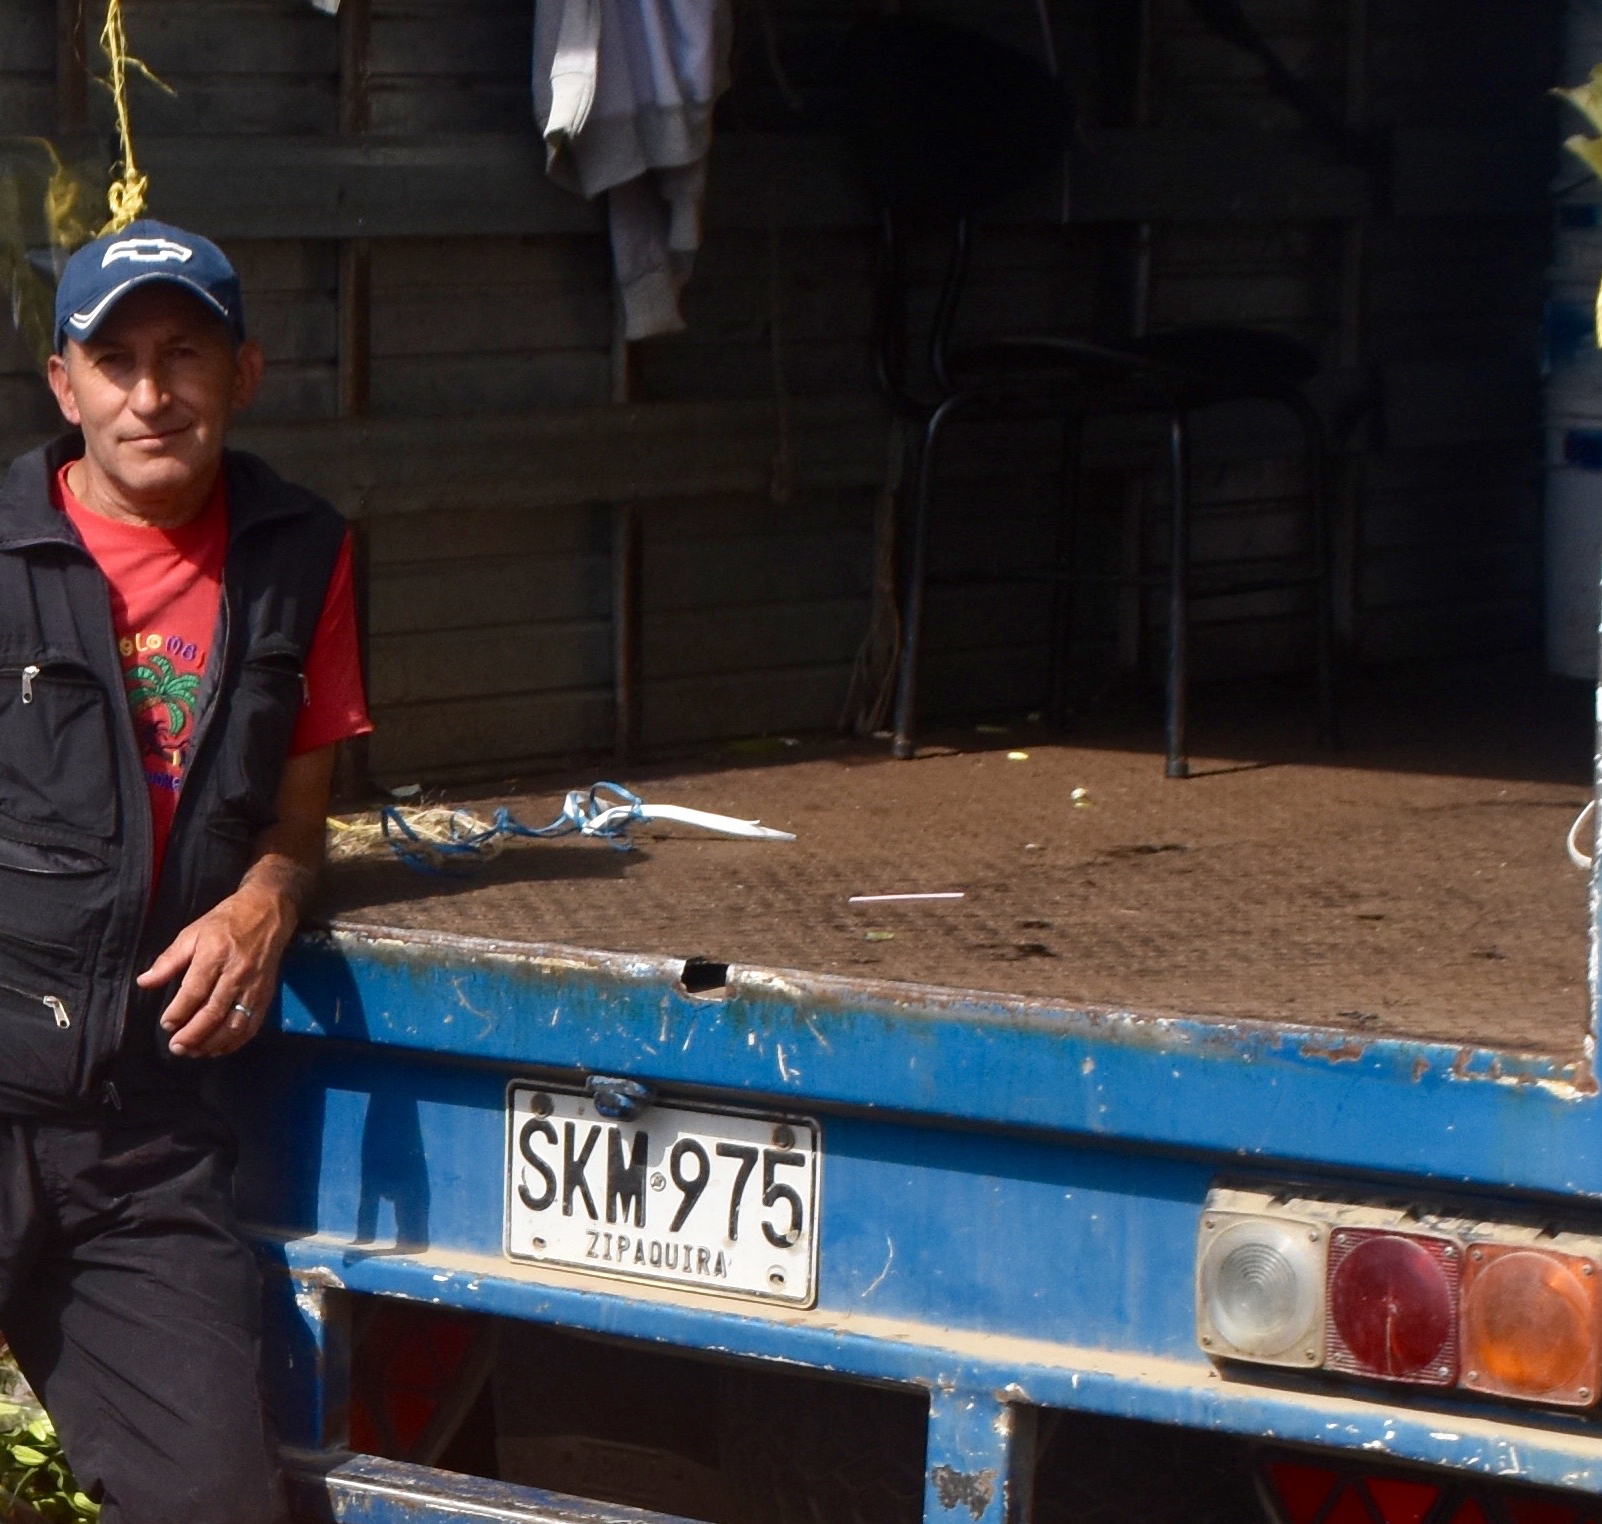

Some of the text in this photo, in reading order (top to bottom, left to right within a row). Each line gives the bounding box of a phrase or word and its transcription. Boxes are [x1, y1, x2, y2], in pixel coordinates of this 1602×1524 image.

[517, 1117, 807, 1250] SKM 975
[585, 1229, 729, 1278] ZIPAQUIRA
